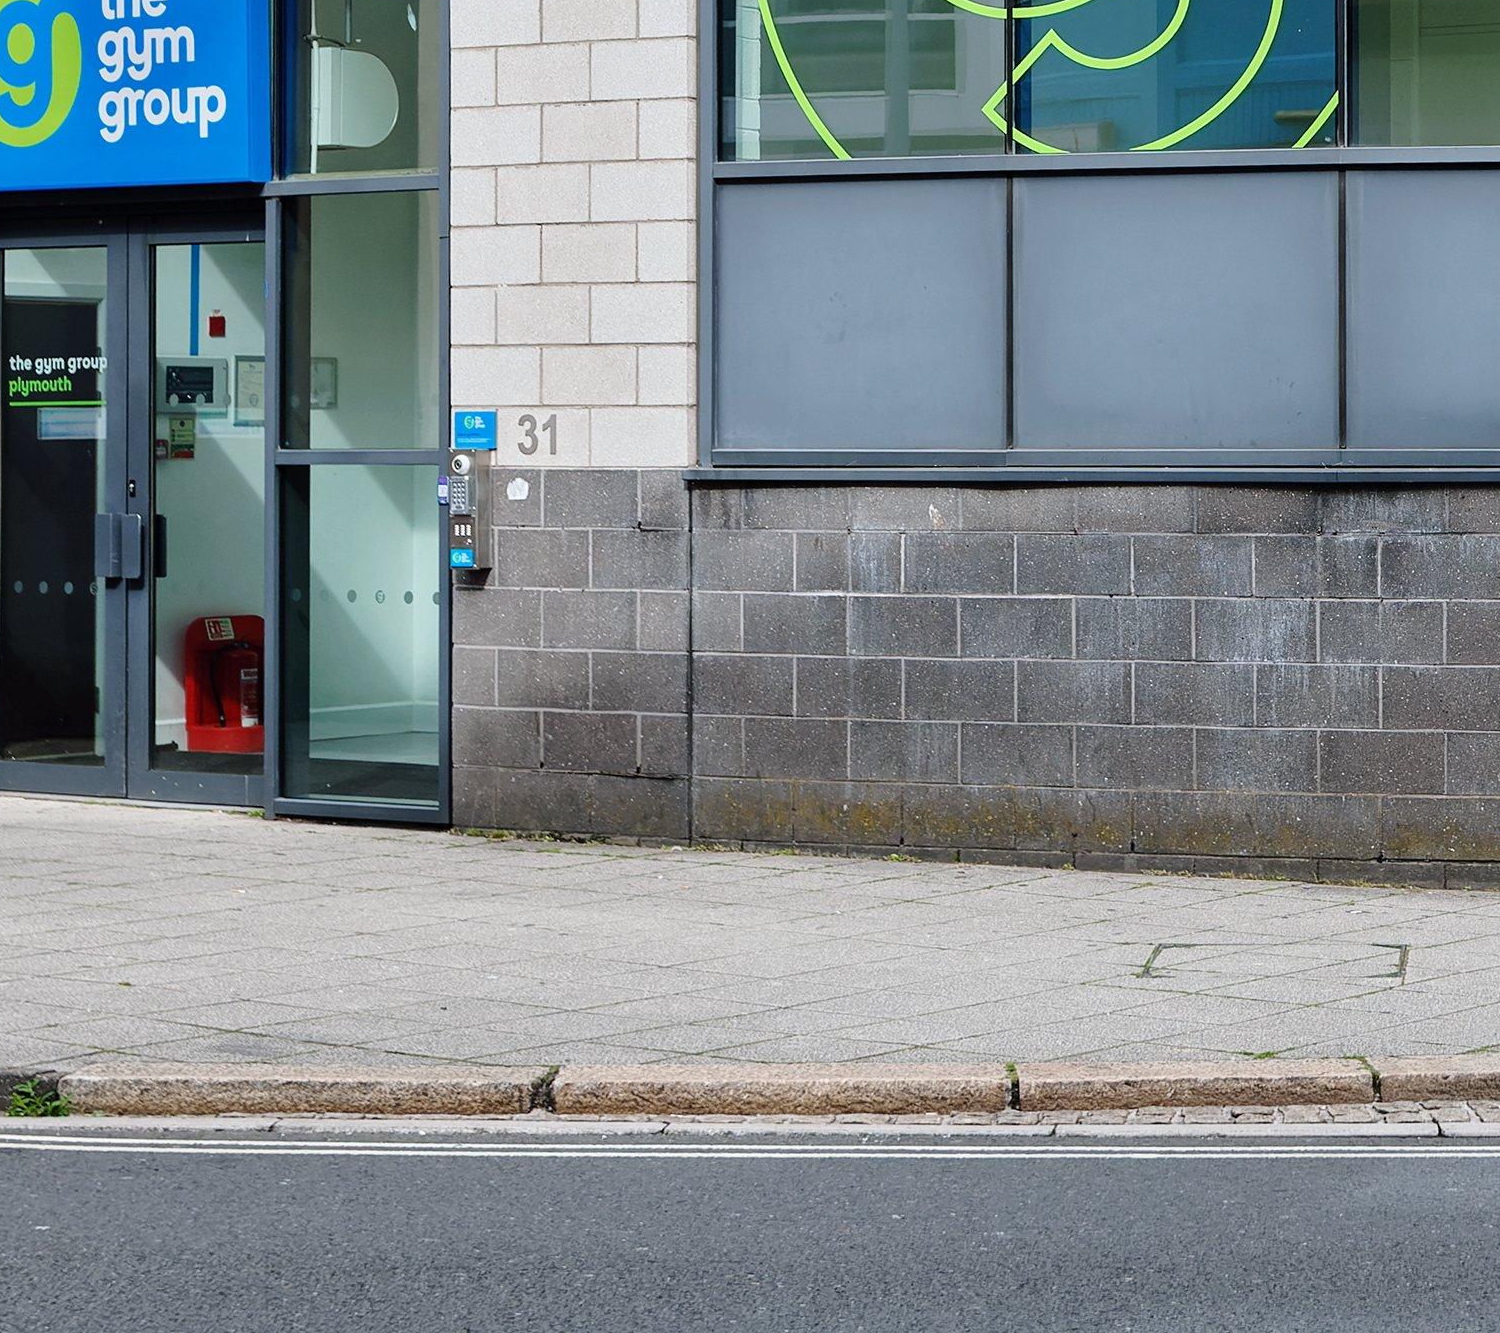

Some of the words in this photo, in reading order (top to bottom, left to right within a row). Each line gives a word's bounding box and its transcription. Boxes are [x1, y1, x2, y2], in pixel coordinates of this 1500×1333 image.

[97, 25, 196, 83] gym
[98, 85, 227, 143] group
[8, 354, 33, 371] the
[34, 357, 65, 375] gym
[67, 356, 108, 375] group
[8, 375, 72, 397] plymouth
[517, 414, 558, 456] 31
